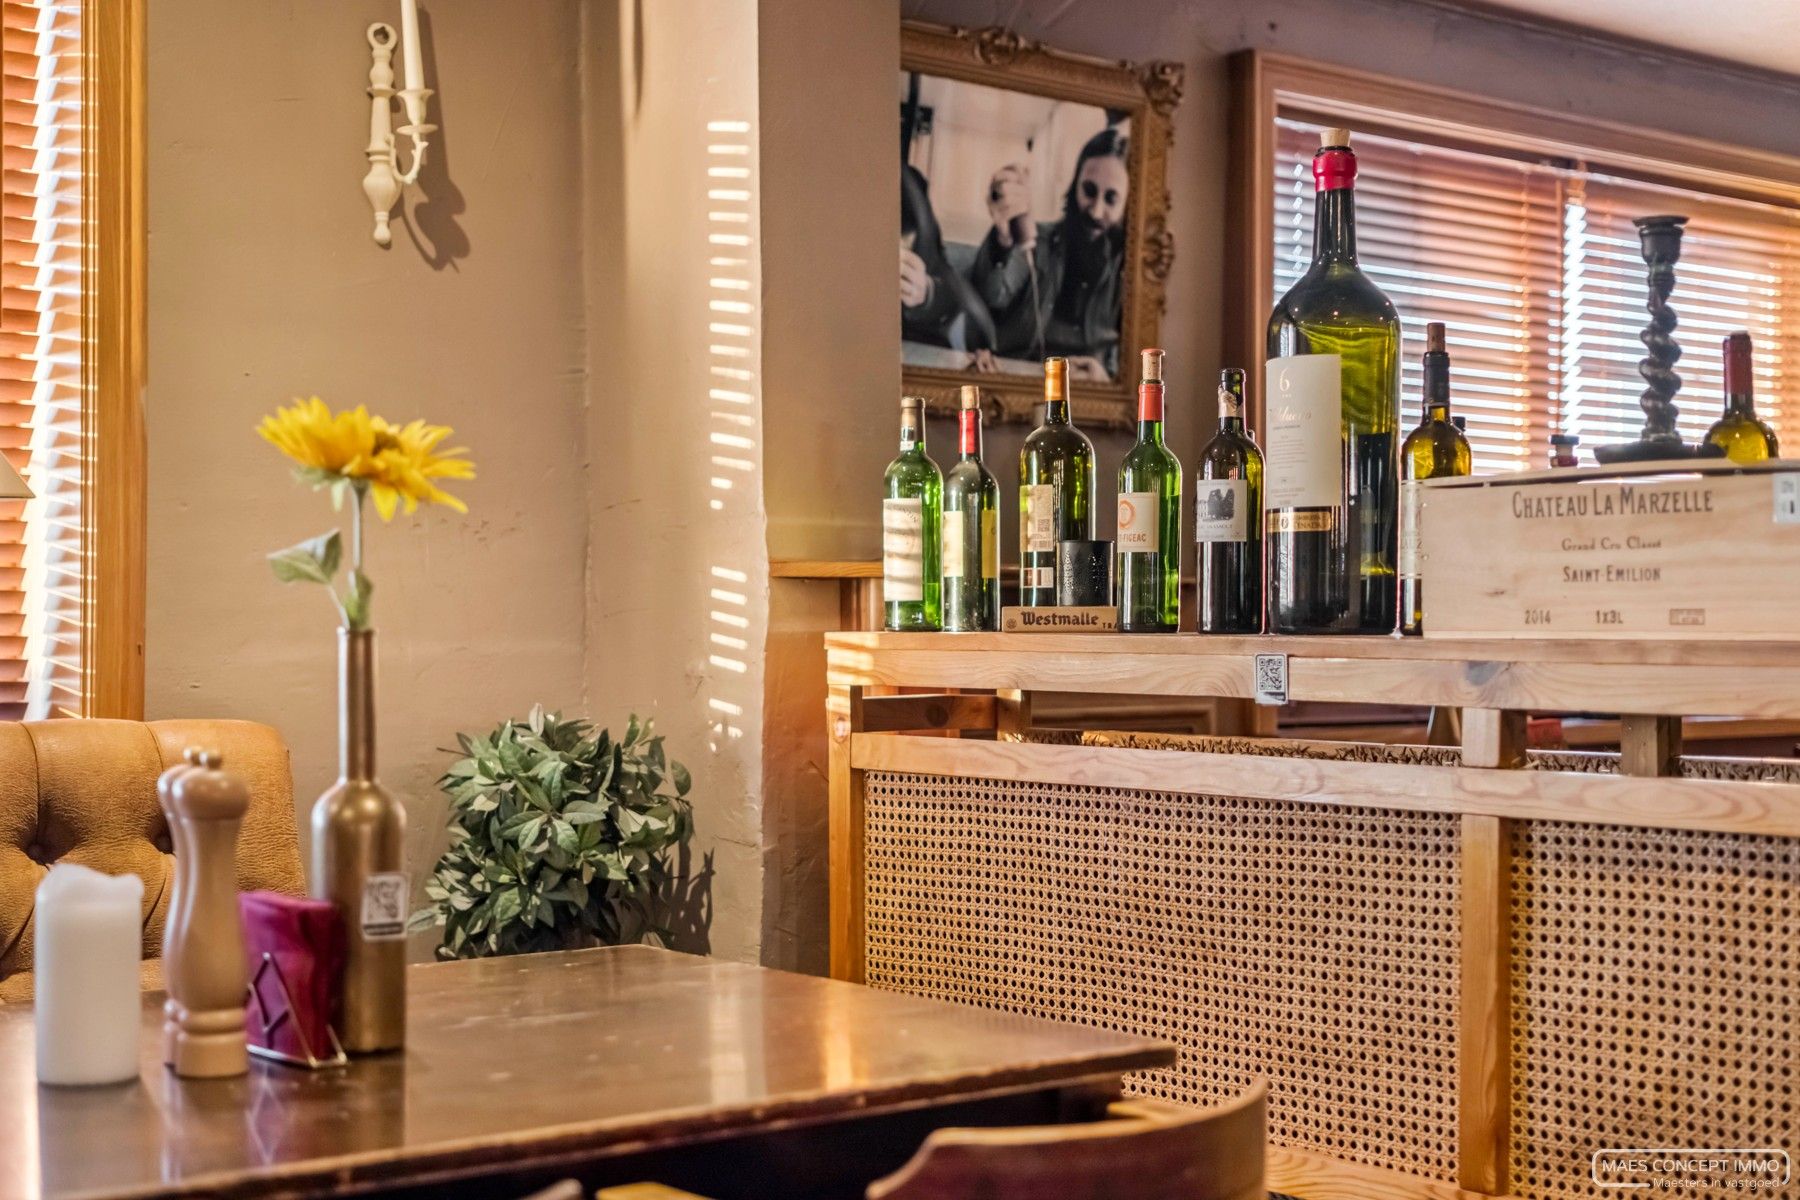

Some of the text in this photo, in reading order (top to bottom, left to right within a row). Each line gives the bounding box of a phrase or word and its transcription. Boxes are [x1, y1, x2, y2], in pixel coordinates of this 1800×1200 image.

[1279, 367, 1291, 392] 6
[1512, 486, 1714, 518] CHATEAU LA MARZELLE
[1561, 538, 1596, 551] Grand
[1600, 536, 1622, 550] Cru
[1021, 611, 1099, 626] Westmalle
[1524, 609, 1552, 625] 2014
